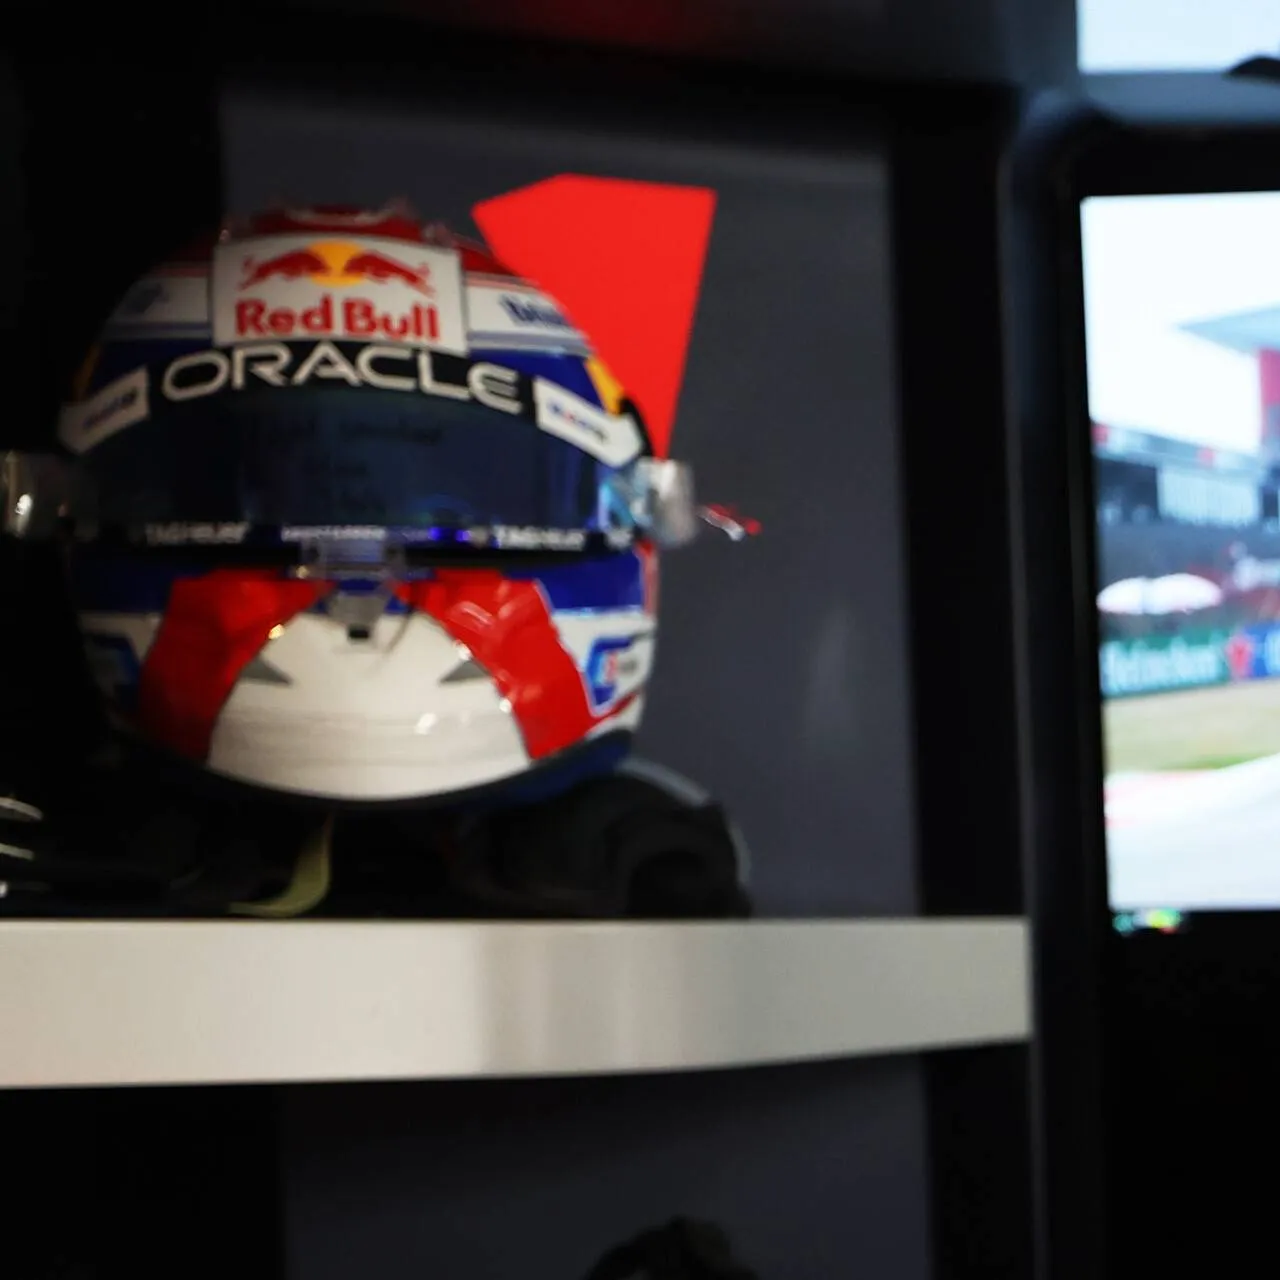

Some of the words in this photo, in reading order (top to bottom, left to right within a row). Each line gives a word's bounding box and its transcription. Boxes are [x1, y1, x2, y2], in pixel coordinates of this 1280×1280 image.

[235, 294, 332, 336] Red
[341, 298, 440, 342] Bull
[162, 340, 523, 416] ORACLE
